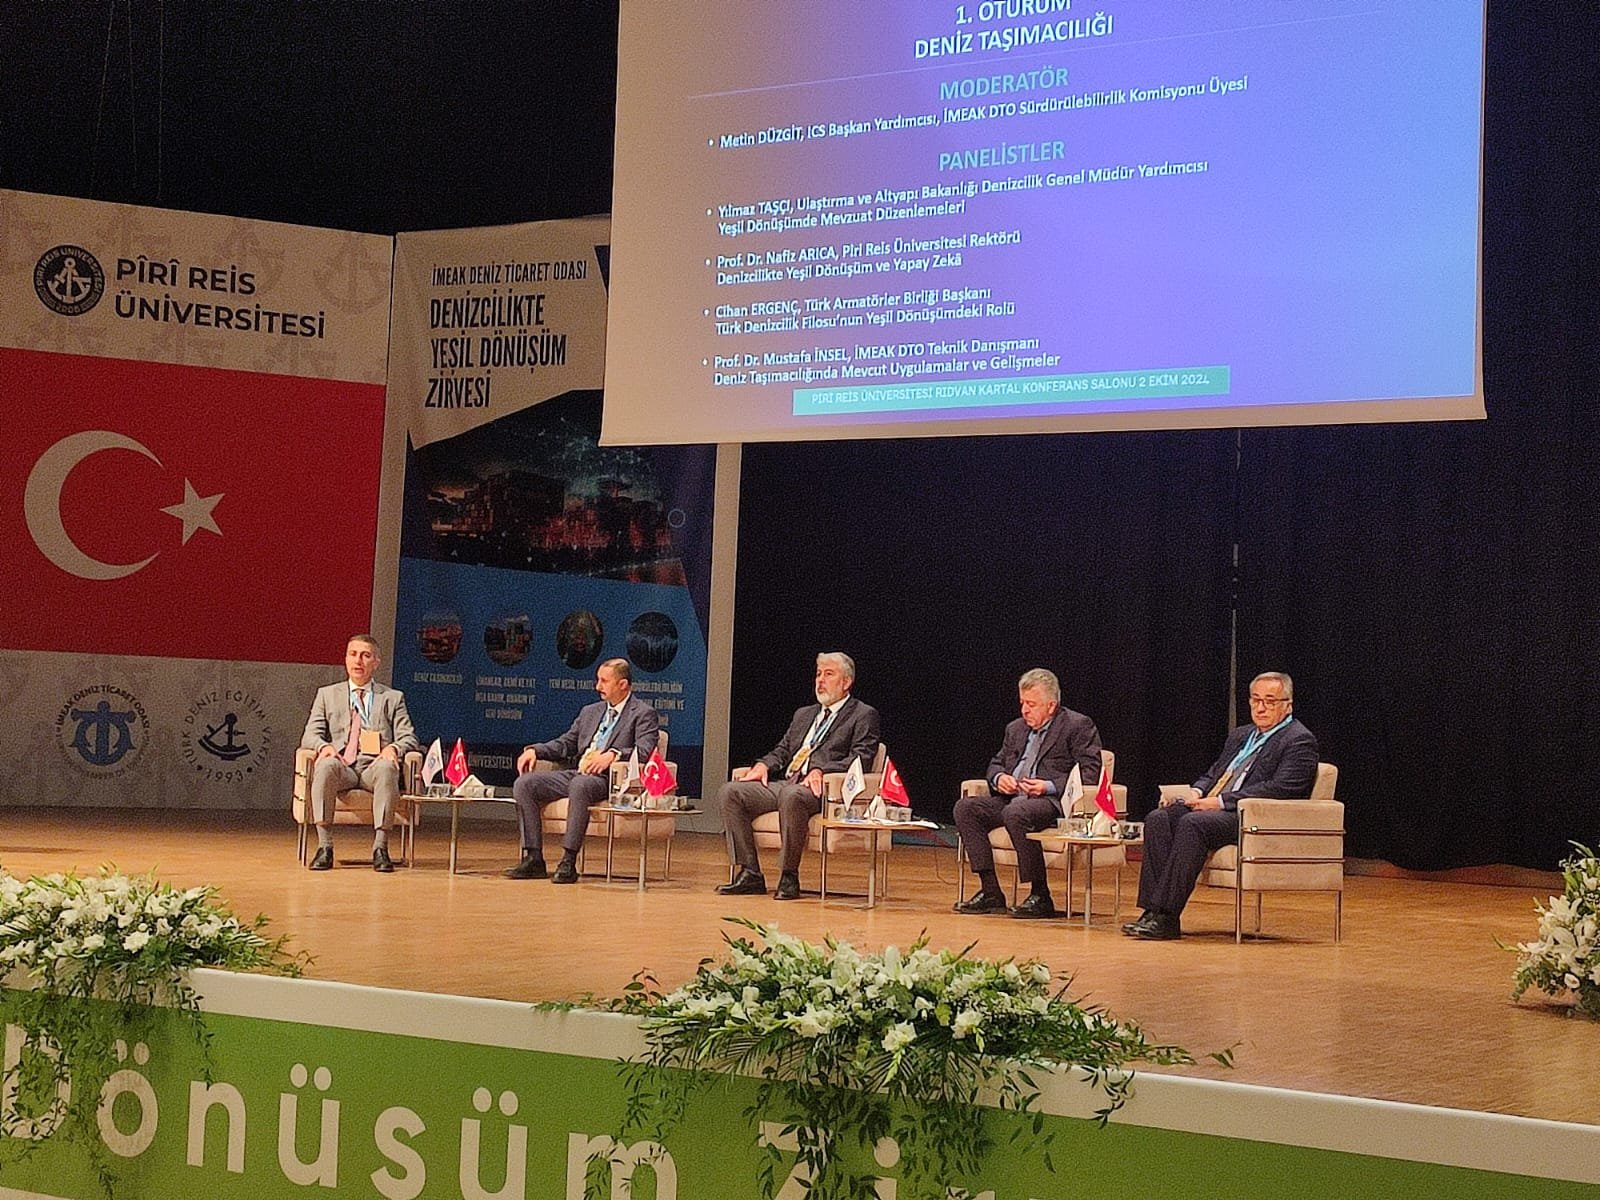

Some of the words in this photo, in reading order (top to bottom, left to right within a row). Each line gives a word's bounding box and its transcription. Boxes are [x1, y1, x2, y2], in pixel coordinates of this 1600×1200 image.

[956, 6, 973, 25] 1.
[978, 0, 1071, 21] OTURUM
[915, 30, 973, 59] DENİZ
[978, 11, 1114, 52] TAŞIMACILIĞI
[940, 66, 1069, 101] MODERATÖR
[719, 134, 755, 149] Metin
[807, 124, 826, 139] ICS
[829, 120, 871, 138] Başkan
[874, 114, 941, 132] Yardımcısı,
[943, 105, 987, 123] İMEAK
[989, 102, 1016, 118] DTO
[1019, 90, 1126, 115] Sürdürülebilirlik
[1129, 84, 1205, 102] Komisyonu
[1209, 75, 1248, 96] Üyesi
[939, 140, 1065, 171] PANELİSTLER
[719, 203, 755, 218] Yılmaz
[797, 195, 854, 212] Ulaştırma
[857, 194, 872, 205] ve
[875, 189, 918, 205] Altyapı
[921, 181, 978, 199] Bakanlığı
[981, 174, 1043, 193] Denizcilik
[1046, 170, 1085, 186] Genel
[1088, 165, 1135, 183] Müdür
[1137, 161, 1208, 178] Yardımcısı
[718, 219, 744, 236] Yeşil
[747, 214, 817, 232] Dönüşümde
[820, 210, 873, 226] Mevzuat
[875, 200, 965, 221] Düzenlemeleri
[717, 253, 744, 268] Prof.
[747, 253, 764, 266] Dr.
[766, 250, 796, 264] Nafiz
[799, 246, 839, 262] ARICA,
[865, 241, 890, 256] Reis
[893, 235, 966, 254] Üniversitesi
[970, 230, 1021, 248] Rektörü
[188, 264, 256, 295] REİS
[432, 264, 467, 286] İMEAK
[470, 260, 501, 284] DENİZ
[505, 259, 550, 283] TİCARET
[553, 260, 588, 281] ODASI
[717, 268, 783, 285] Denizcilikte
[786, 264, 812, 281] Yeşil
[815, 259, 873, 278] Dönüşüm
[875, 262, 890, 272] ve
[893, 257, 929, 273] Yapay
[115, 289, 325, 339] ÜNİVERSİTESİ
[430, 288, 546, 329] DENİZCİLİKTE
[715, 303, 748, 318] Cihan
[751, 300, 801, 316] ERGENÇ,
[804, 298, 831, 312] Türk
[832, 292, 901, 310] Armatörler
[903, 289, 939, 305] Birliği
[942, 287, 991, 303] Başkanı
[715, 321, 741, 335] Türk
[744, 318, 799, 333] Denizcilik
[866, 310, 893, 327] Yeşil
[896, 304, 983, 323] Dönüşümdeki
[986, 301, 1015, 317] Rolü
[480, 329, 567, 374] DÖNÜŞÜM
[714, 354, 741, 368] Prof.
[744, 354, 760, 367] Dr.
[763, 350, 811, 365] Mustafa
[814, 347, 852, 363] İNSEL,
[854, 344, 895, 360] İMEAK
[898, 343, 925, 357] DTO
[927, 339, 968, 355] Teknik
[971, 338, 1039, 354] Danışmanı
[714, 372, 746, 386] Deniz
[749, 366, 838, 386] Taşımacılığında
[841, 363, 887, 378] Mevcut
[890, 359, 969, 378] Uygulamalar
[972, 360, 987, 371] ve
[990, 353, 1061, 371] Gelişmeler
[978, 382, 1020, 396] KARTAL
[1023, 378, 1089, 393] KONFERANS
[1091, 376, 1137, 390] SALONU
[1139, 376, 1146, 388] 2
[1181, 374, 1210, 386] 2024
[425, 369, 491, 408] ZİRVESİ
